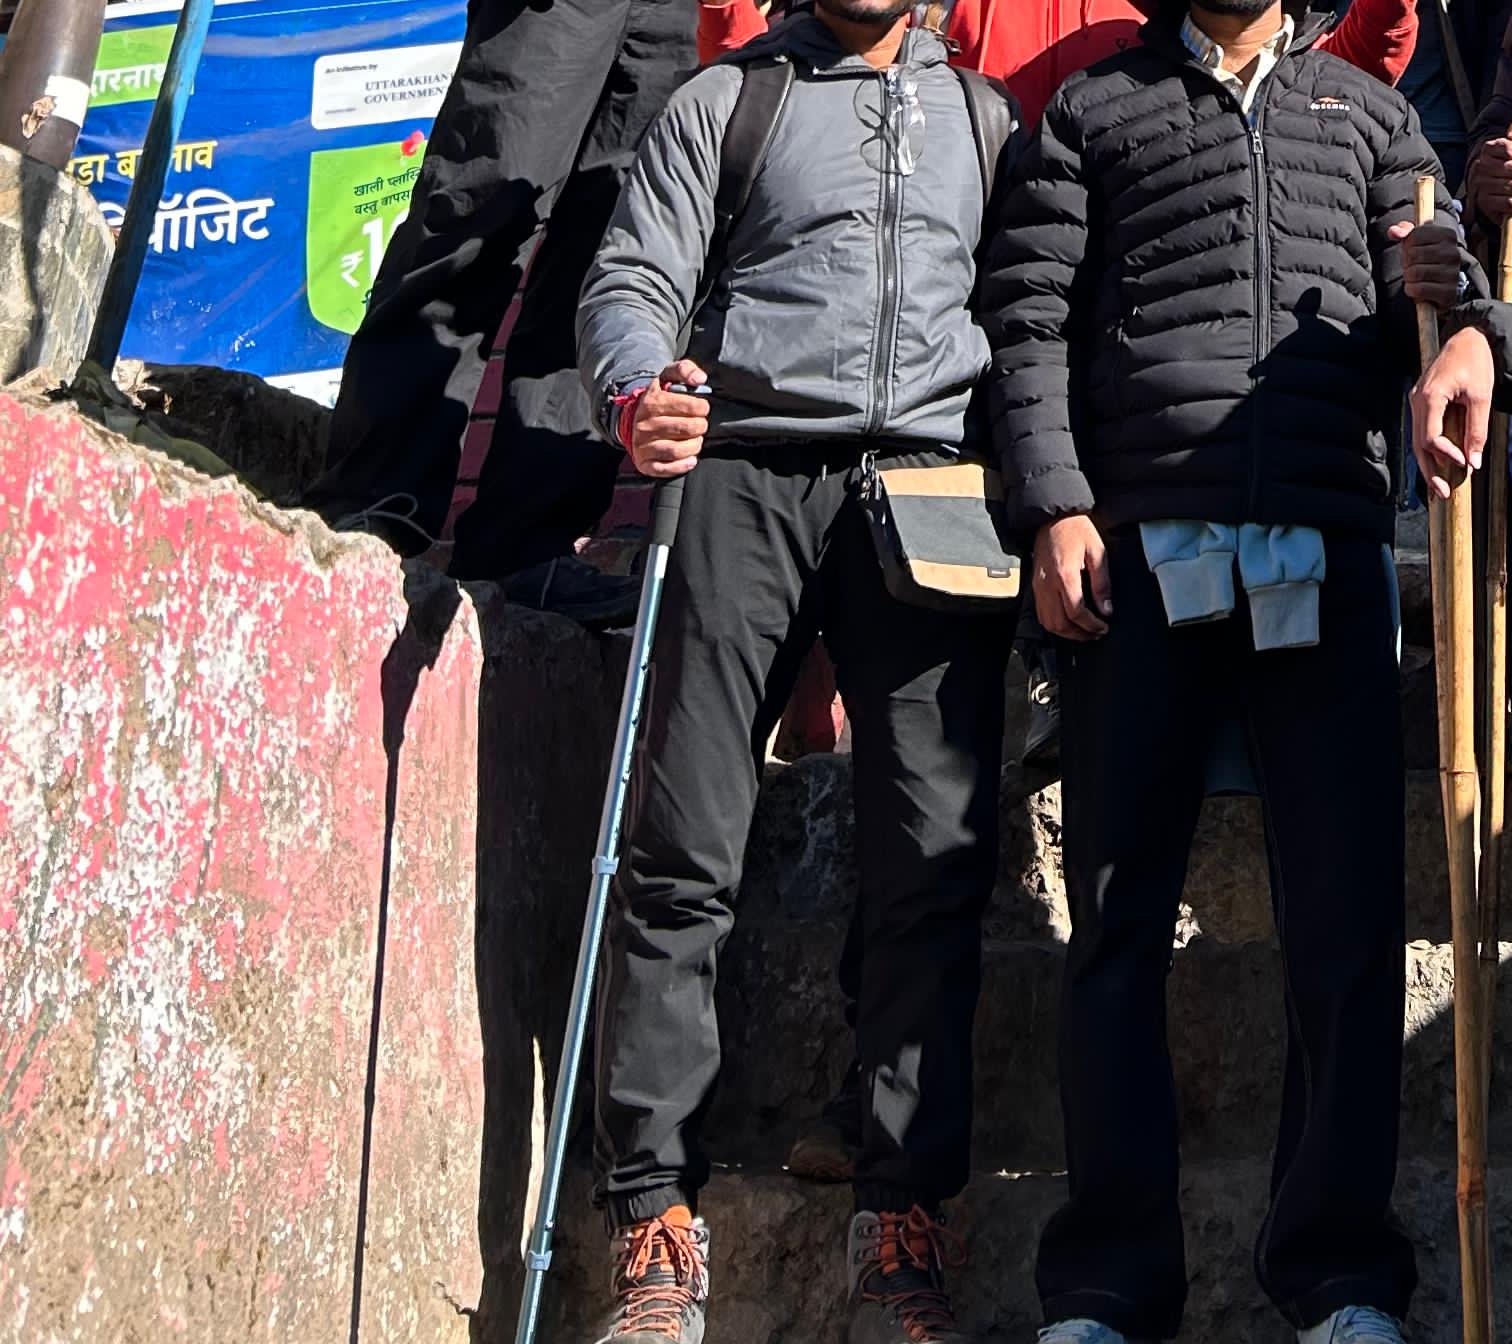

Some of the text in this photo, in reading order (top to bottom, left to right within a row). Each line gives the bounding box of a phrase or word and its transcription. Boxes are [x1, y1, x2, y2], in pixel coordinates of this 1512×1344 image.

[364, 86, 446, 105] GOVERNMEN
[353, 176, 383, 197] खाली
[381, 189, 410, 207] वापस
